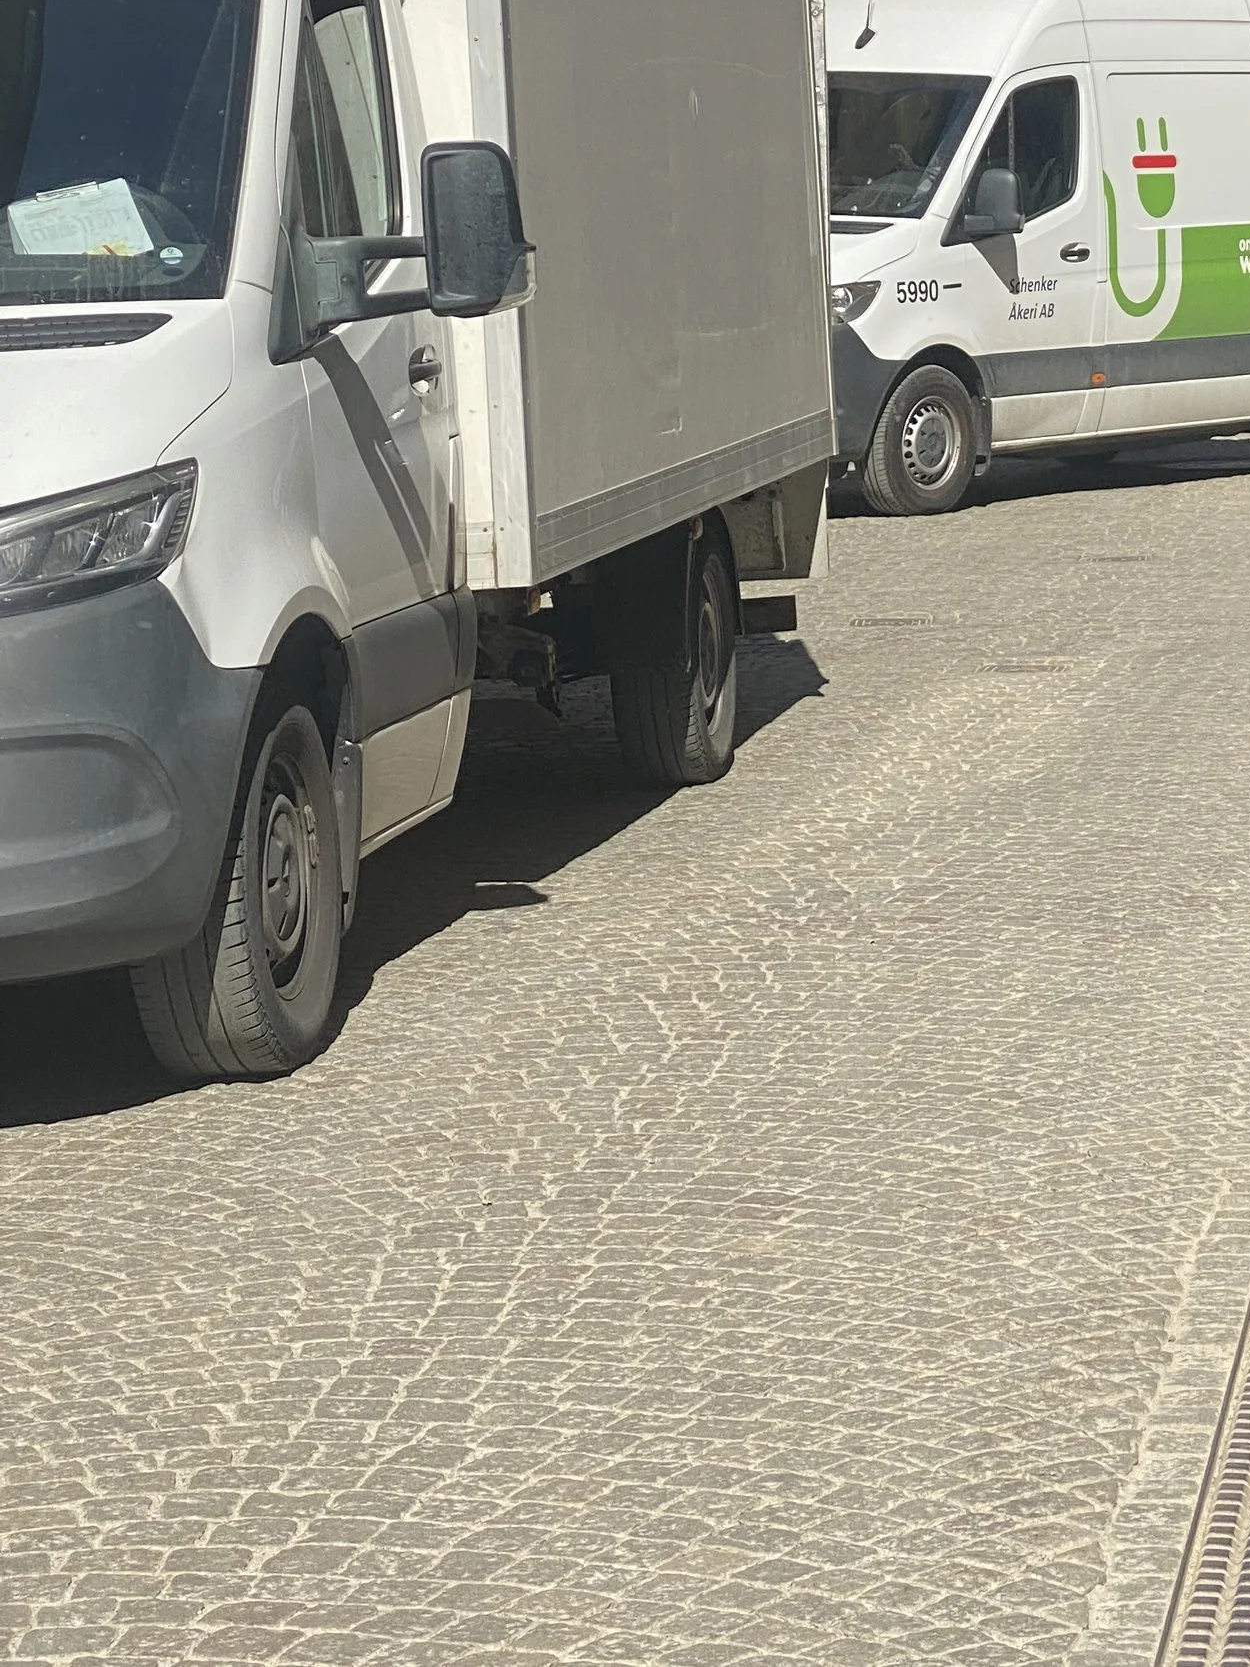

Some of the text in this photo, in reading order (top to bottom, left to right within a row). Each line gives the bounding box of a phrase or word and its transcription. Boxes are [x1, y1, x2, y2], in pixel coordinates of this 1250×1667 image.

[896, 279, 939, 304] 5990
[1009, 275, 1058, 294] Schenker
[1008, 301, 1055, 320] Åkeri AB
